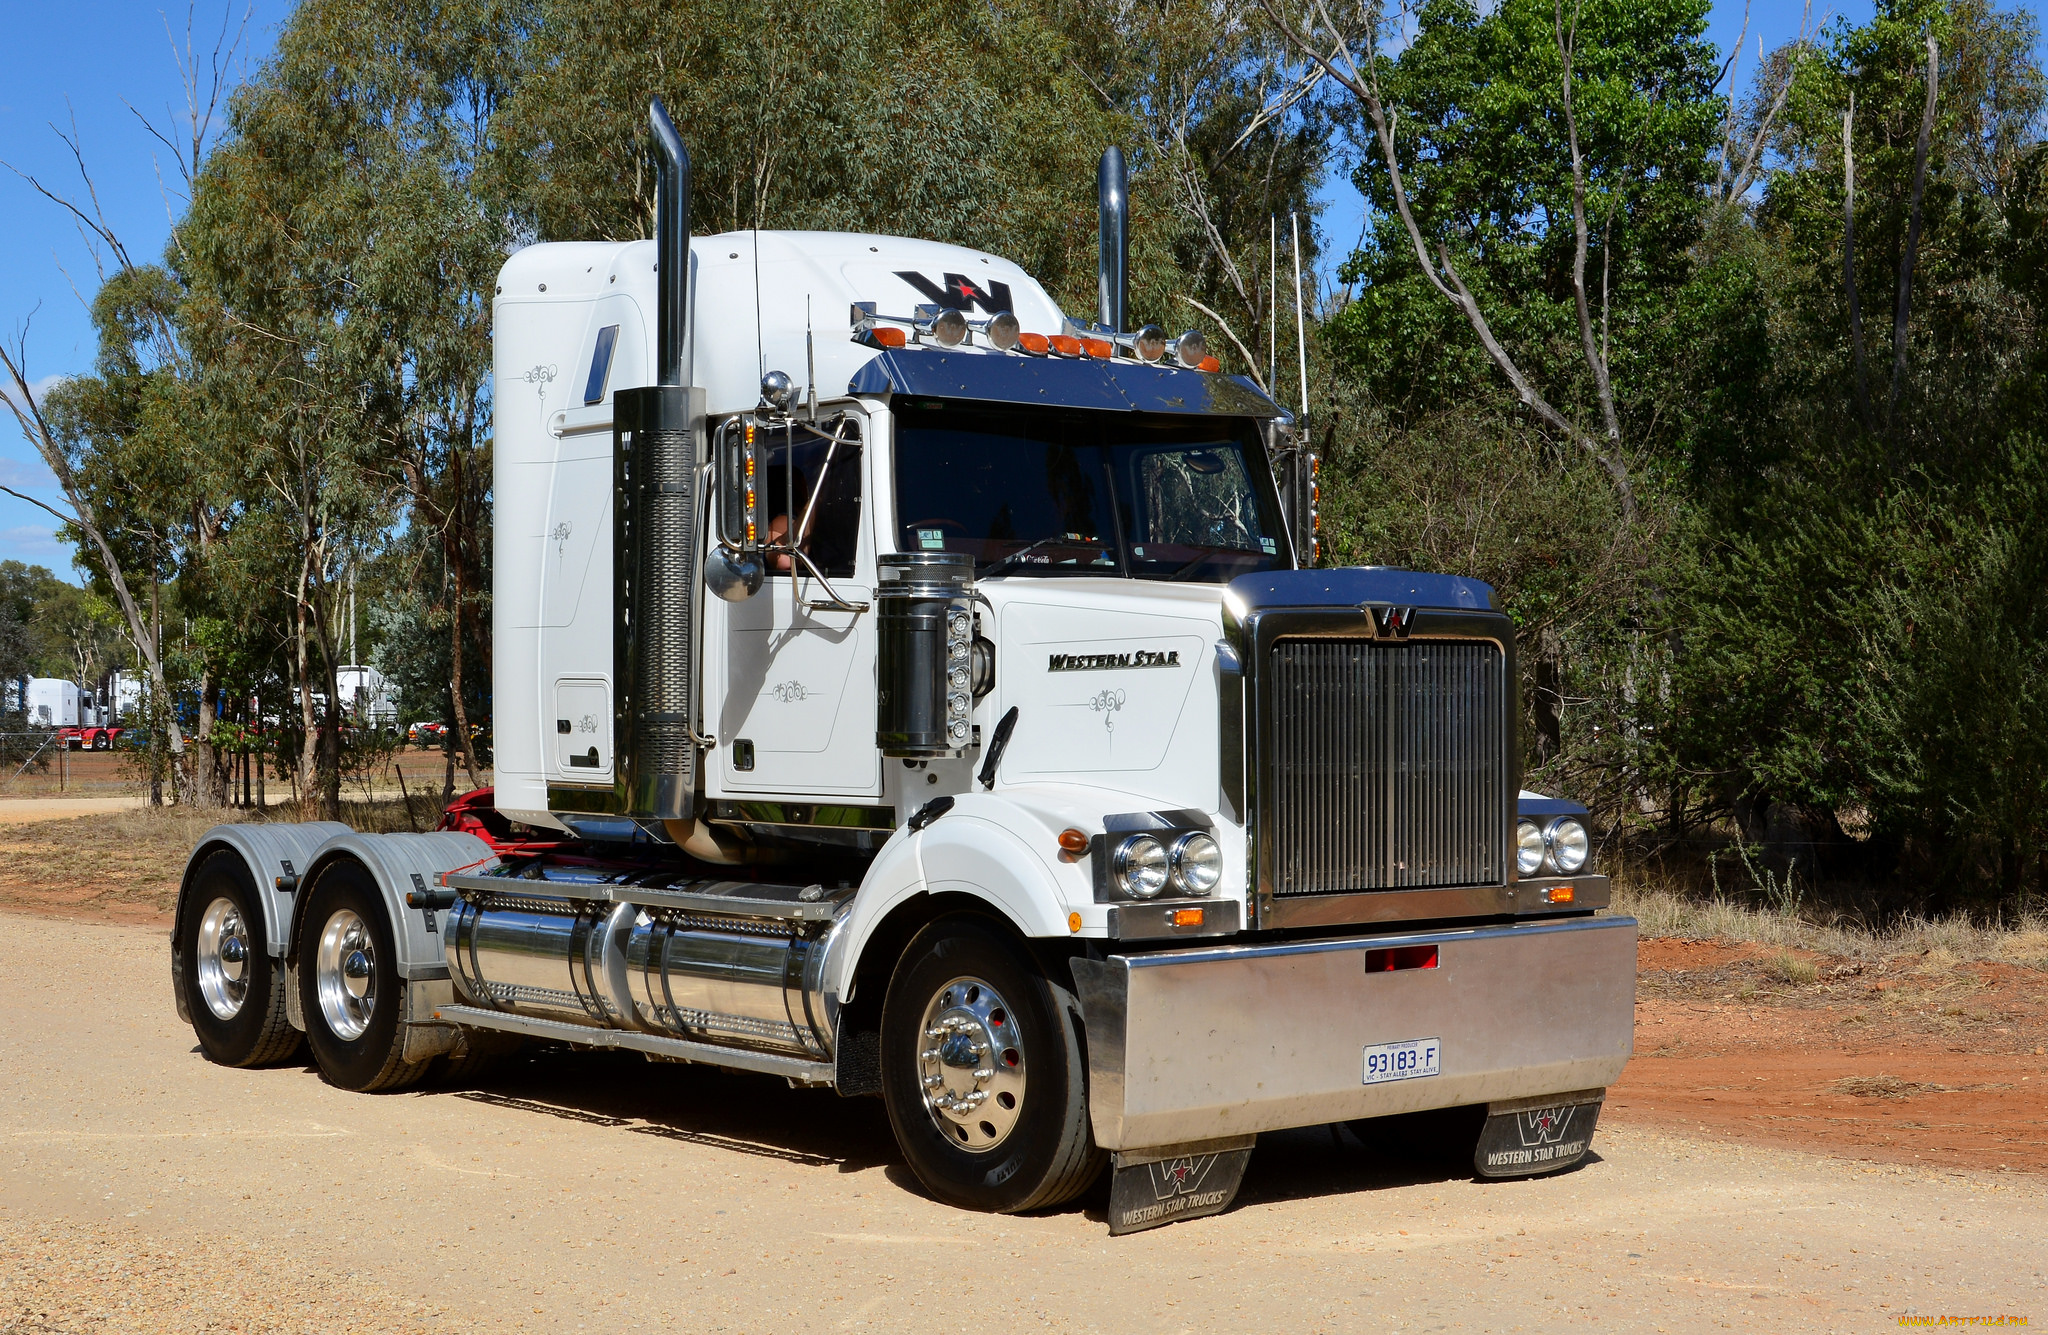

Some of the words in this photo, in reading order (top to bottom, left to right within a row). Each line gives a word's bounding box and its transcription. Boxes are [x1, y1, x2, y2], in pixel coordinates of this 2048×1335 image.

[1049, 653, 1130, 671] WESTERN
[1133, 650, 1179, 667] STAR
[1487, 1149, 1532, 1165] WESTERN
[1534, 1147, 1553, 1161] STAR
[1555, 1141, 1582, 1157] TRUCKS
[1122, 1200, 1165, 1226] WESTERN
[1165, 1198, 1184, 1214] STAR
[1187, 1191, 1223, 1208] TRUCKS
